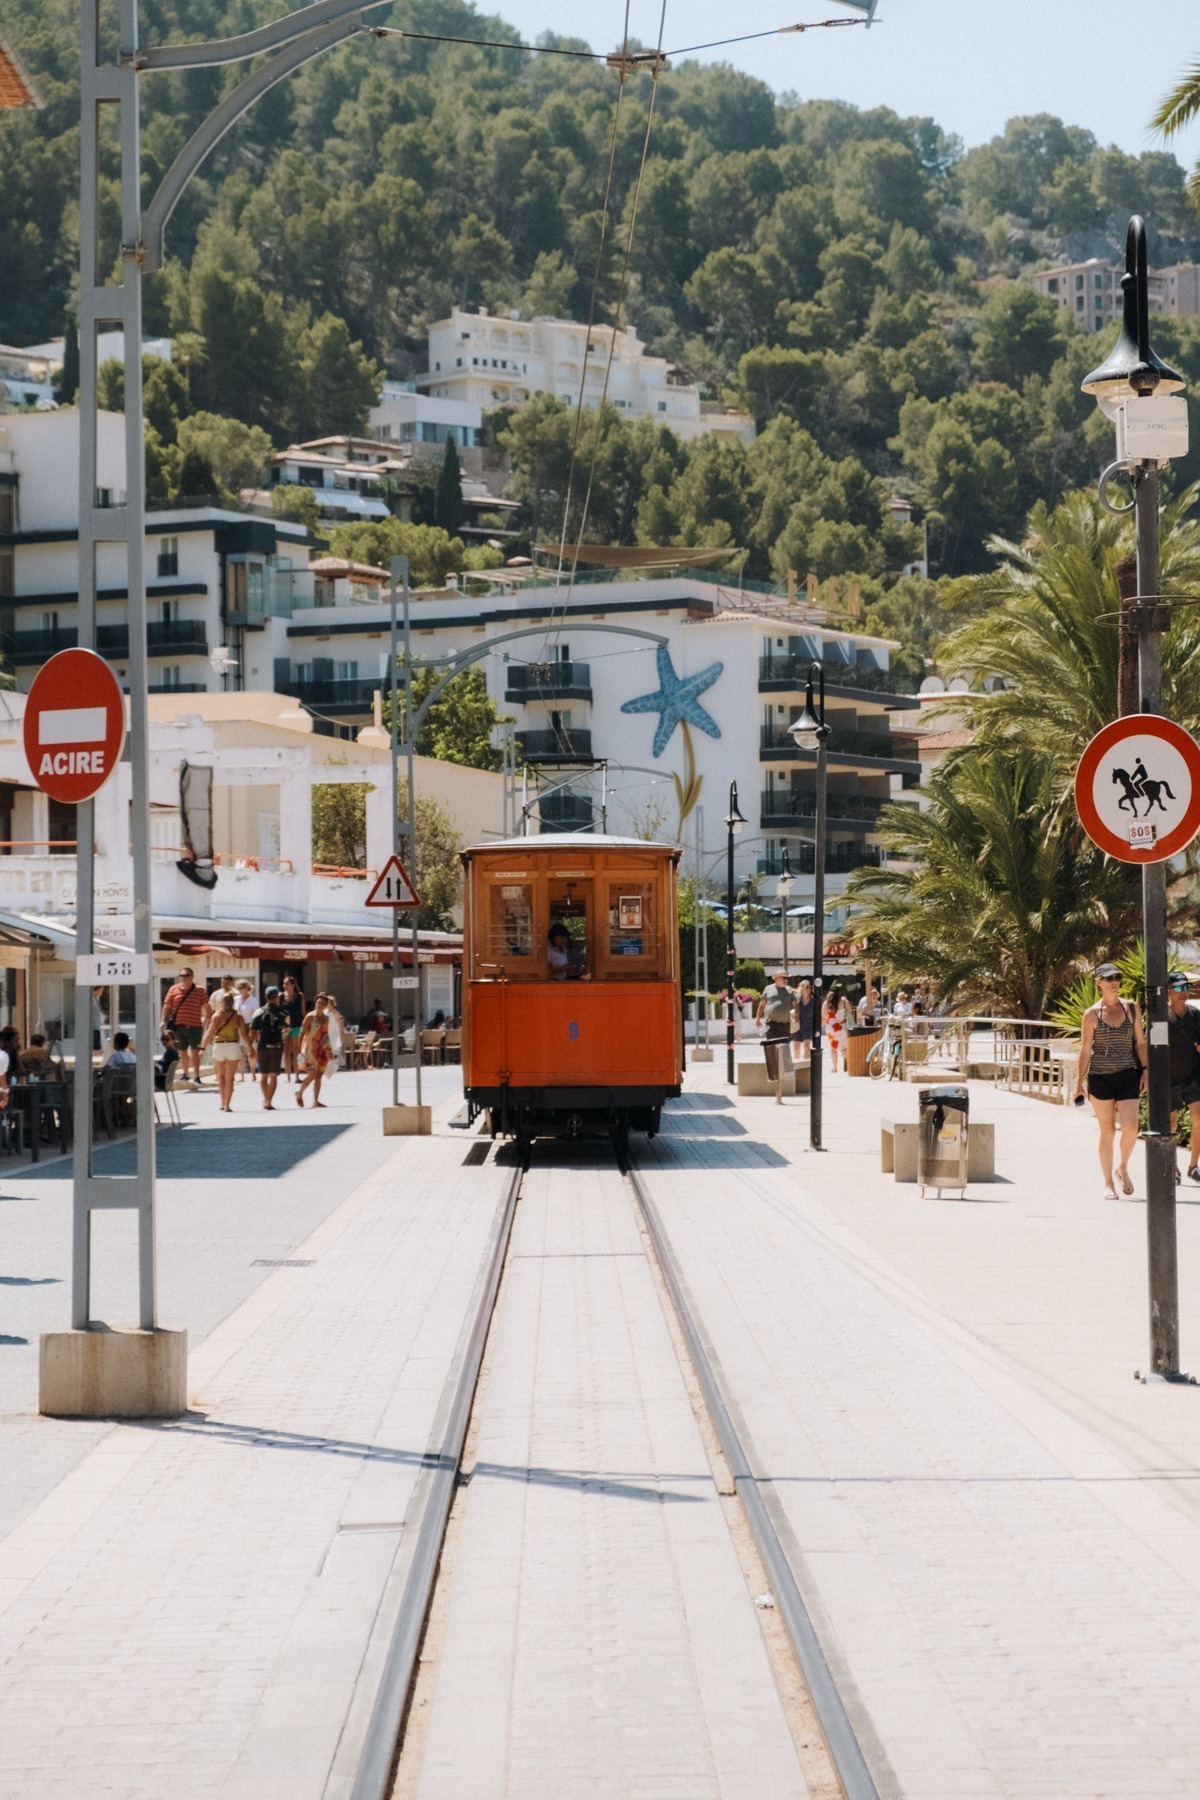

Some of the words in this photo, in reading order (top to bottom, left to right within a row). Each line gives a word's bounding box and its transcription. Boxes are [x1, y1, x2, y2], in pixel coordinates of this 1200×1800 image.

[787, 568, 860, 617] EDEN
[38, 751, 104, 776] ACIRE
[1131, 826, 1150, 838] SOS
[568, 1021, 578, 1040] 9
